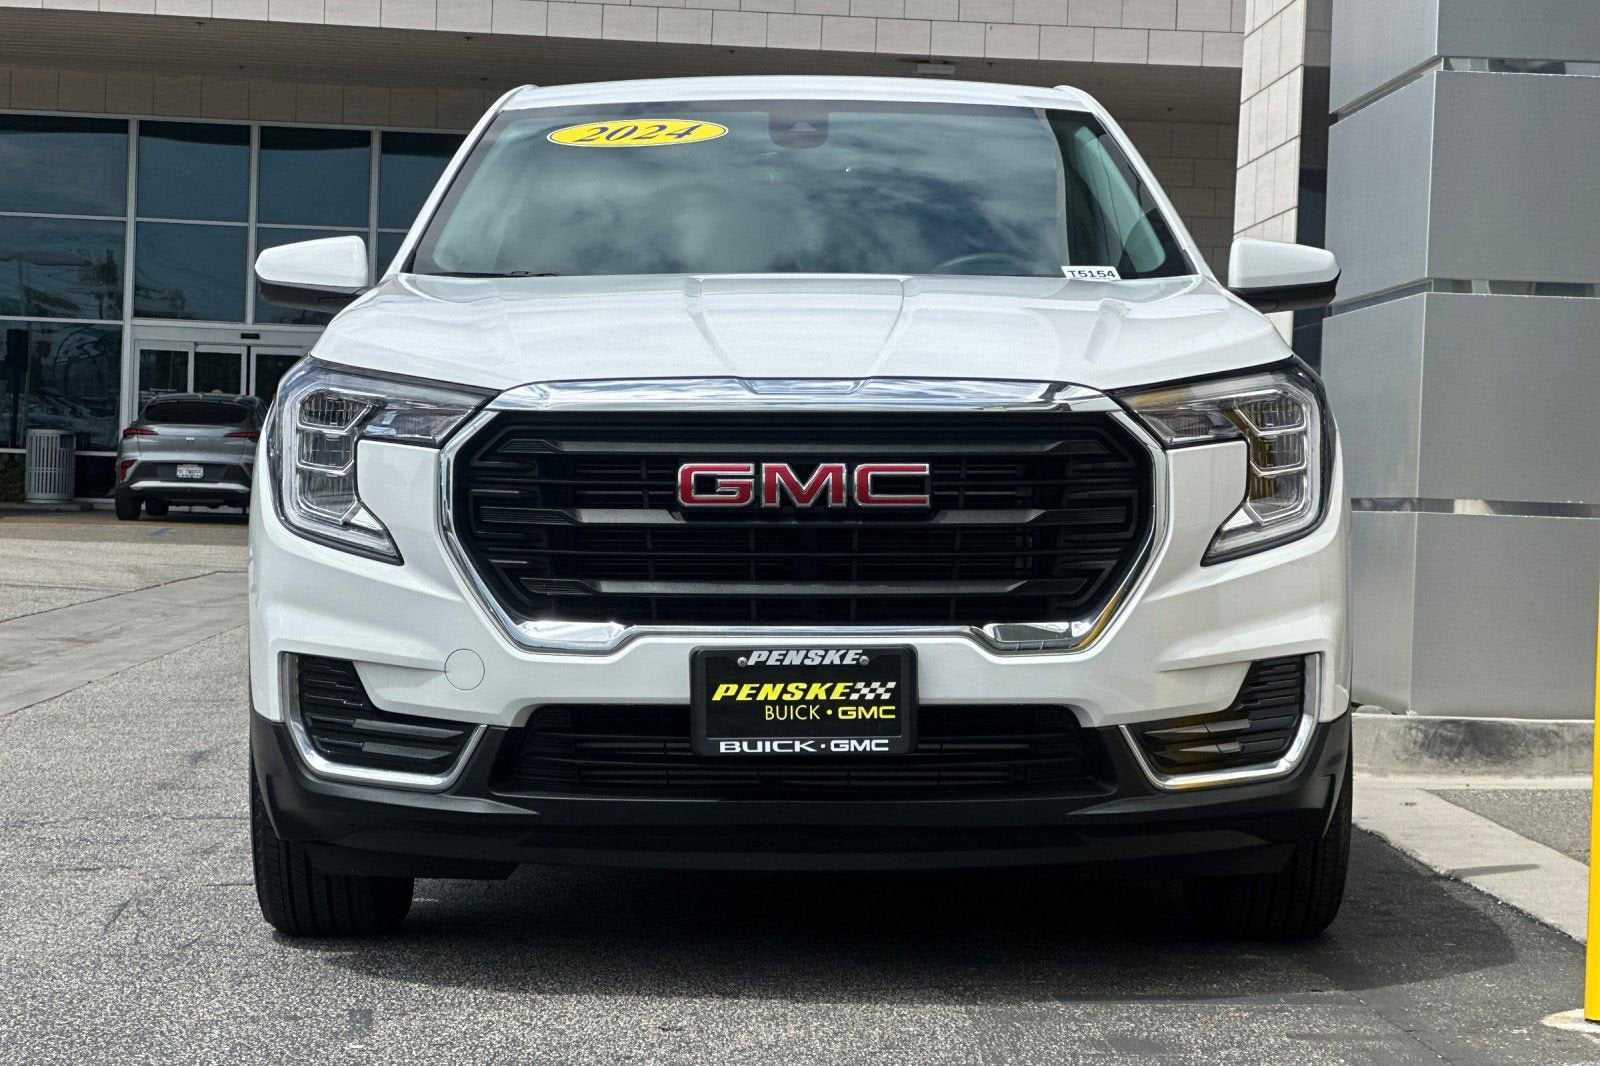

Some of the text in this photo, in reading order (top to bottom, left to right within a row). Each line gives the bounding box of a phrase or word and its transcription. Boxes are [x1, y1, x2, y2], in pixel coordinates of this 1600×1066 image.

[573, 123, 703, 142] 2024
[1067, 270, 1116, 278] T5154
[677, 462, 930, 507] GMC
[747, 650, 863, 666] PENSKE
[712, 683, 854, 701] PENSKE
[765, 705, 896, 721] BUICK GMC
[719, 739, 889, 753] BUICK GMC
